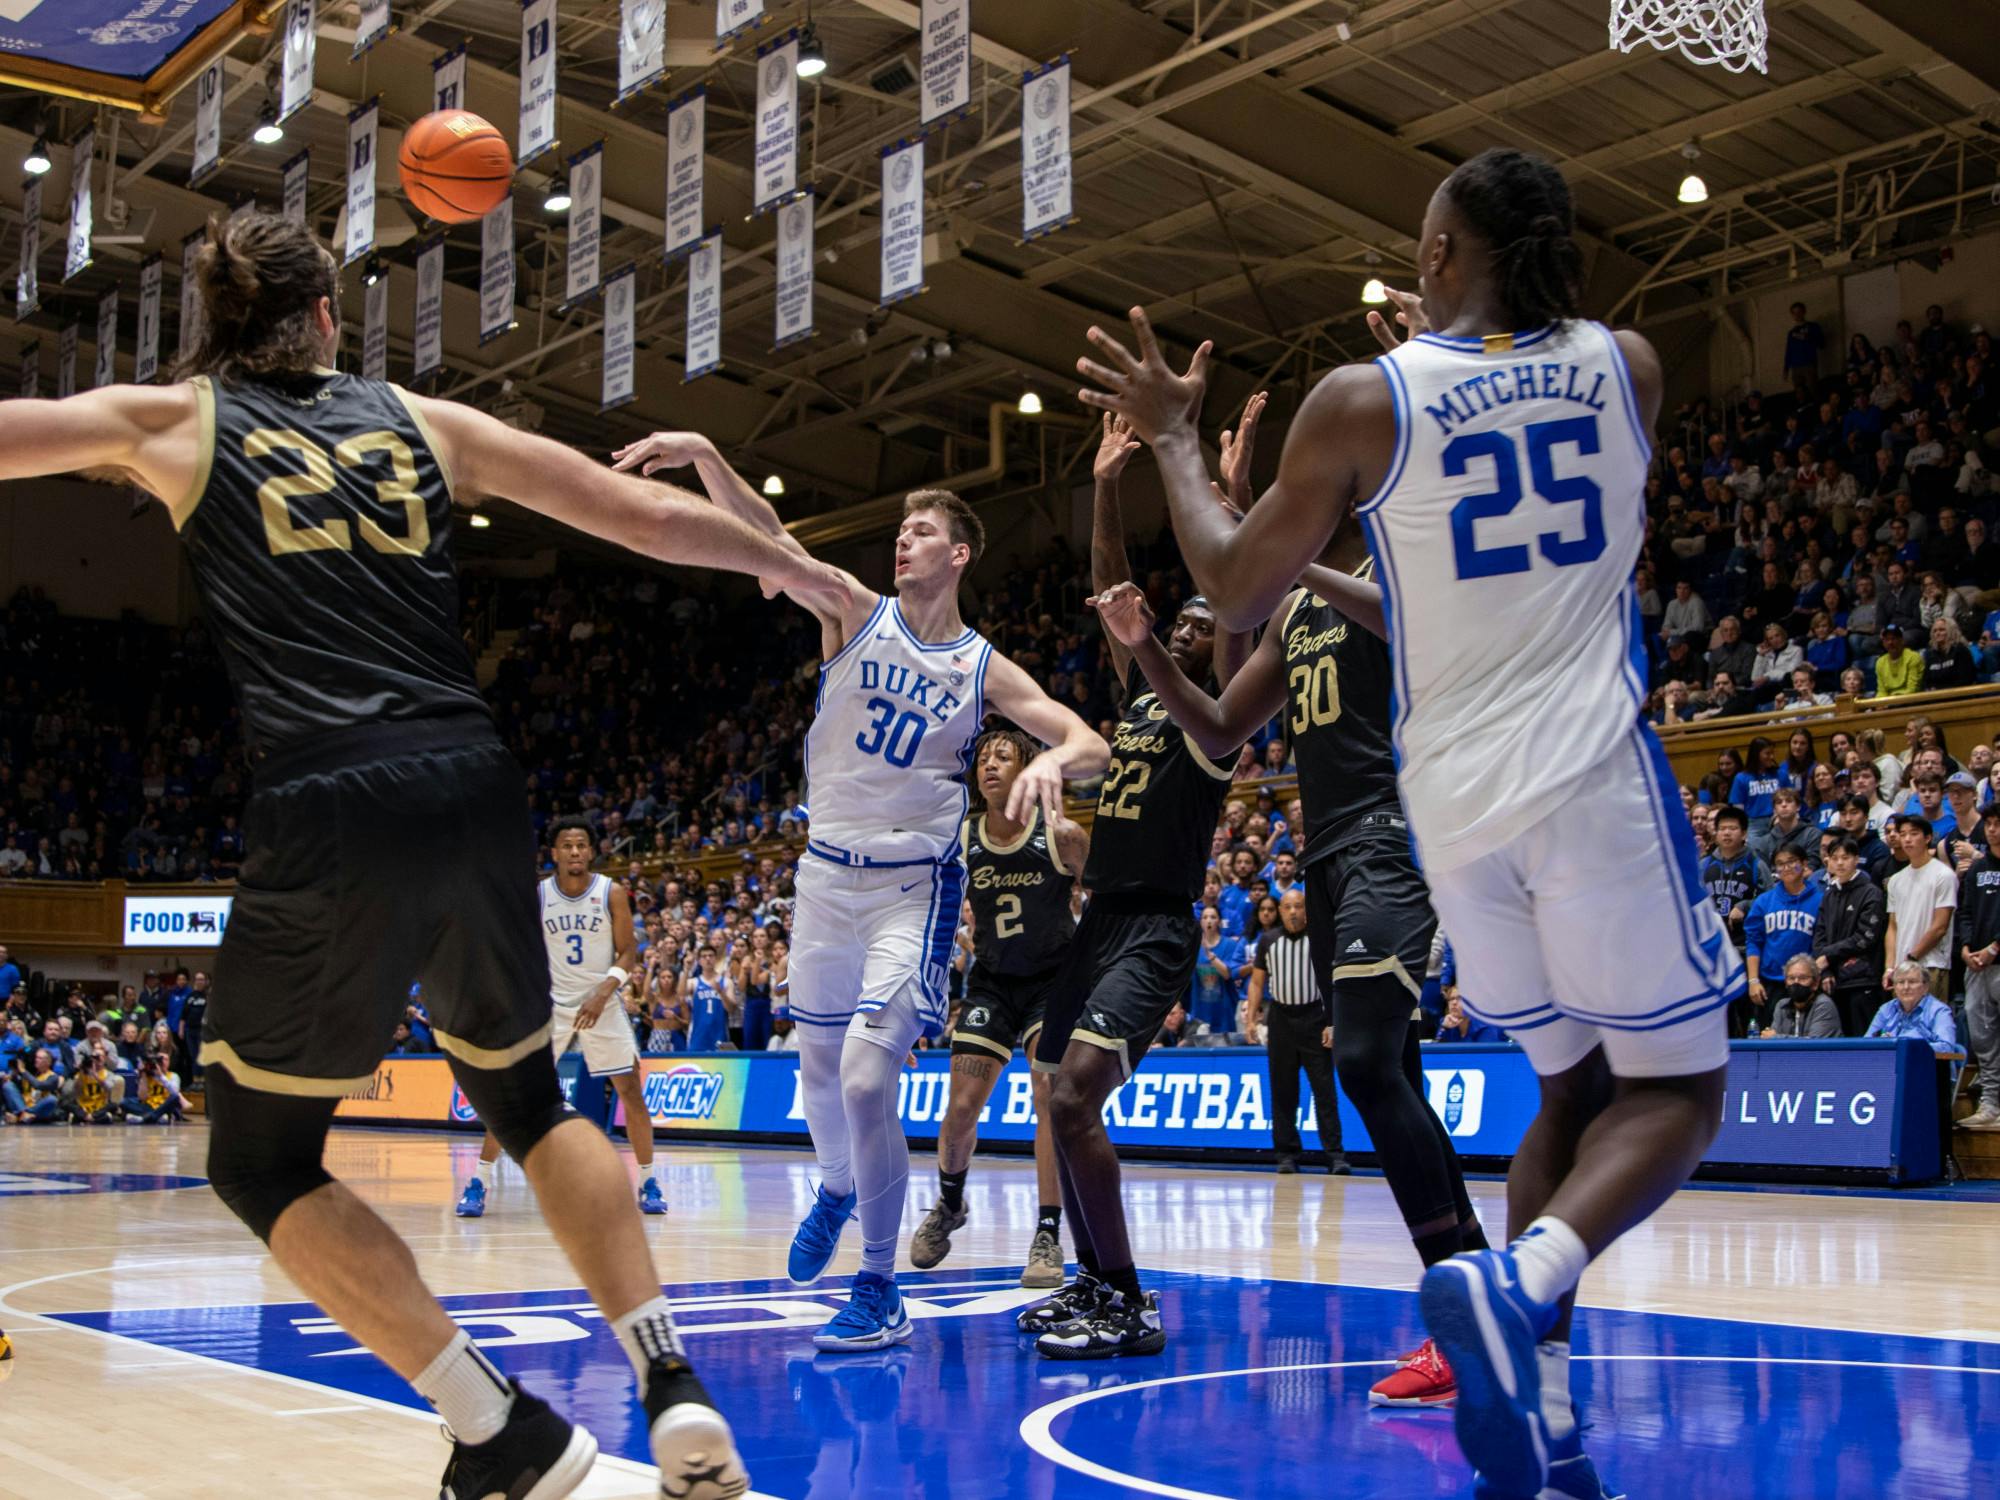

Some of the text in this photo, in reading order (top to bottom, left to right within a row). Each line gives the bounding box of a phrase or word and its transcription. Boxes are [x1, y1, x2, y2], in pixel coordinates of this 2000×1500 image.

[929, 8, 960, 34] ATLANTIC
[934, 25, 956, 47] COAST
[922, 34, 967, 68] CONFERENCE
[924, 51, 964, 82] CHAMPIONS
[763, 101, 789, 123] ATLANTIC
[766, 117, 785, 136] COAST
[756, 126, 794, 154] CONFERENCE
[757, 141, 793, 167] CHAMPIONS
[889, 201, 916, 219] ATLANTIC
[892, 215, 911, 231] COAST
[1424, 364, 1607, 435] MITCHELL
[244, 428, 431, 558] 23
[1442, 415, 1608, 581] 25
[1286, 623, 1349, 662] Braves
[861, 661, 960, 722] DUKE
[1290, 655, 1342, 735] 30
[856, 697, 928, 768] 30
[1112, 721, 1168, 753] Braves
[1097, 758, 1151, 819] 22
[972, 866, 1045, 889] Braves
[995, 894, 1024, 938] 2
[1716, 898, 1732, 916] 3
[130, 913, 184, 932] FOOD
[545, 914, 602, 934] DUKE
[1764, 911, 1816, 936] DUKE
[566, 935, 583, 965] 3
[707, 999, 713, 1014] 1
[642, 1073, 724, 1120] HI-CHEW
[1721, 1090, 1876, 1125] ILWEG
